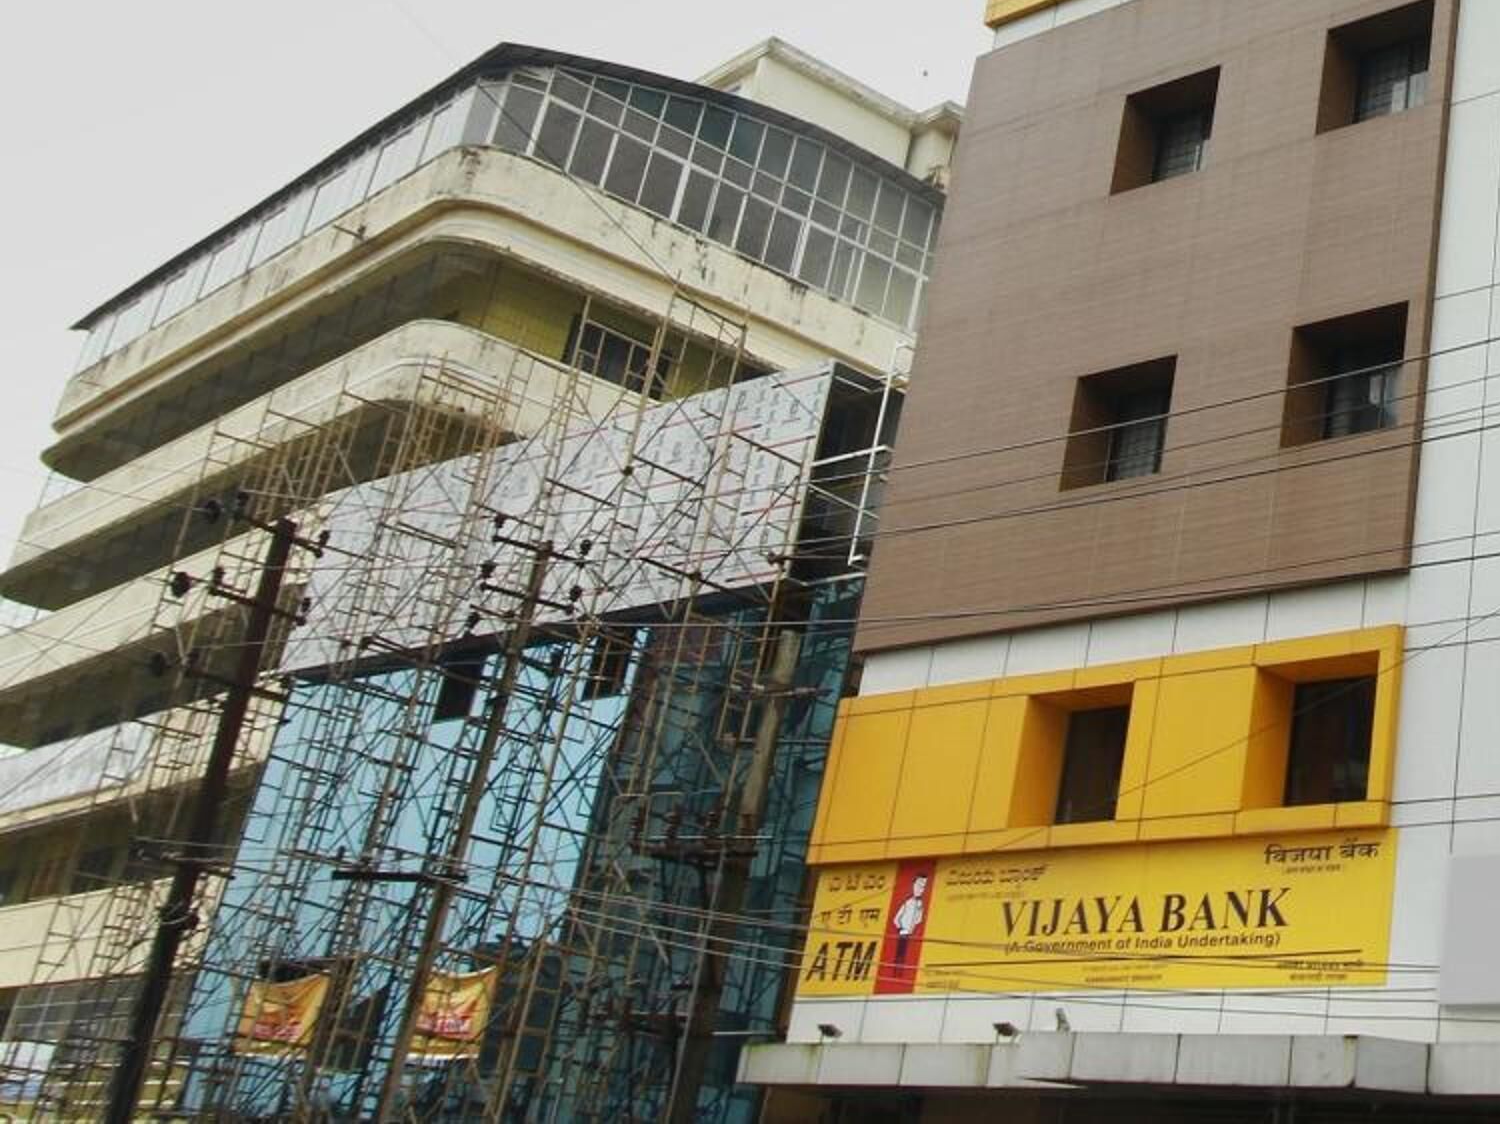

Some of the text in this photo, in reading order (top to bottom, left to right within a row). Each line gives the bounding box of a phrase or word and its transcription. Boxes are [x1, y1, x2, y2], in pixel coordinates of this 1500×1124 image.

[1264, 843, 1334, 864] विजया
[1001, 887, 1292, 938] VIJAYA BANK
[1022, 936, 1112, 955] Government
[1115, 936, 1132, 950] of
[1134, 934, 1173, 949] India
[1176, 929, 1281, 949] Undertaking)
[805, 940, 878, 982] ATM
